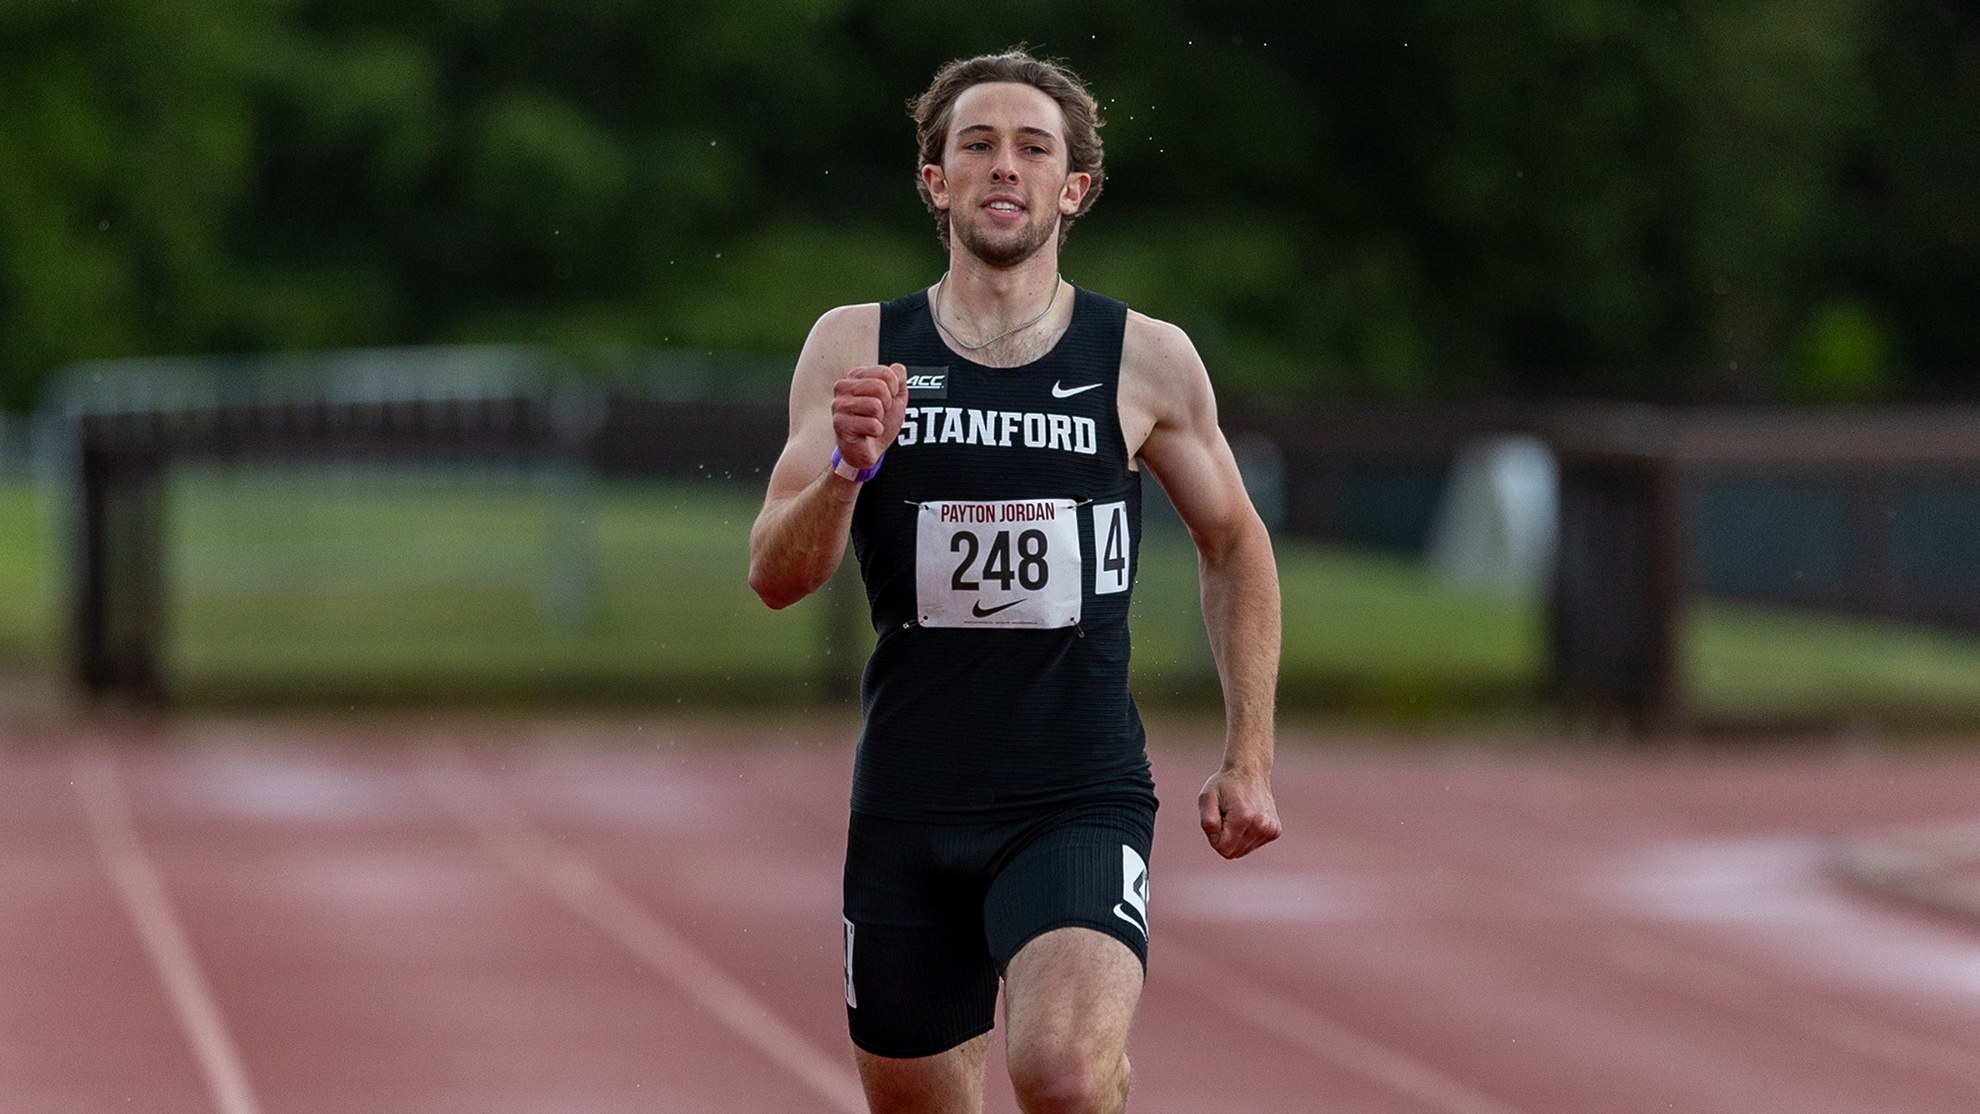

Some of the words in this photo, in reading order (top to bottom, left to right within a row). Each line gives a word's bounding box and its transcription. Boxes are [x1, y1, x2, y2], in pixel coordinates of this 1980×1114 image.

[906, 375, 945, 386] ACC
[898, 407, 1097, 455] STANFORD
[941, 504, 996, 523] PAYTON
[1000, 502, 1055, 522] JORDAN
[950, 529, 1049, 591] 248
[1103, 507, 1126, 587] 4
